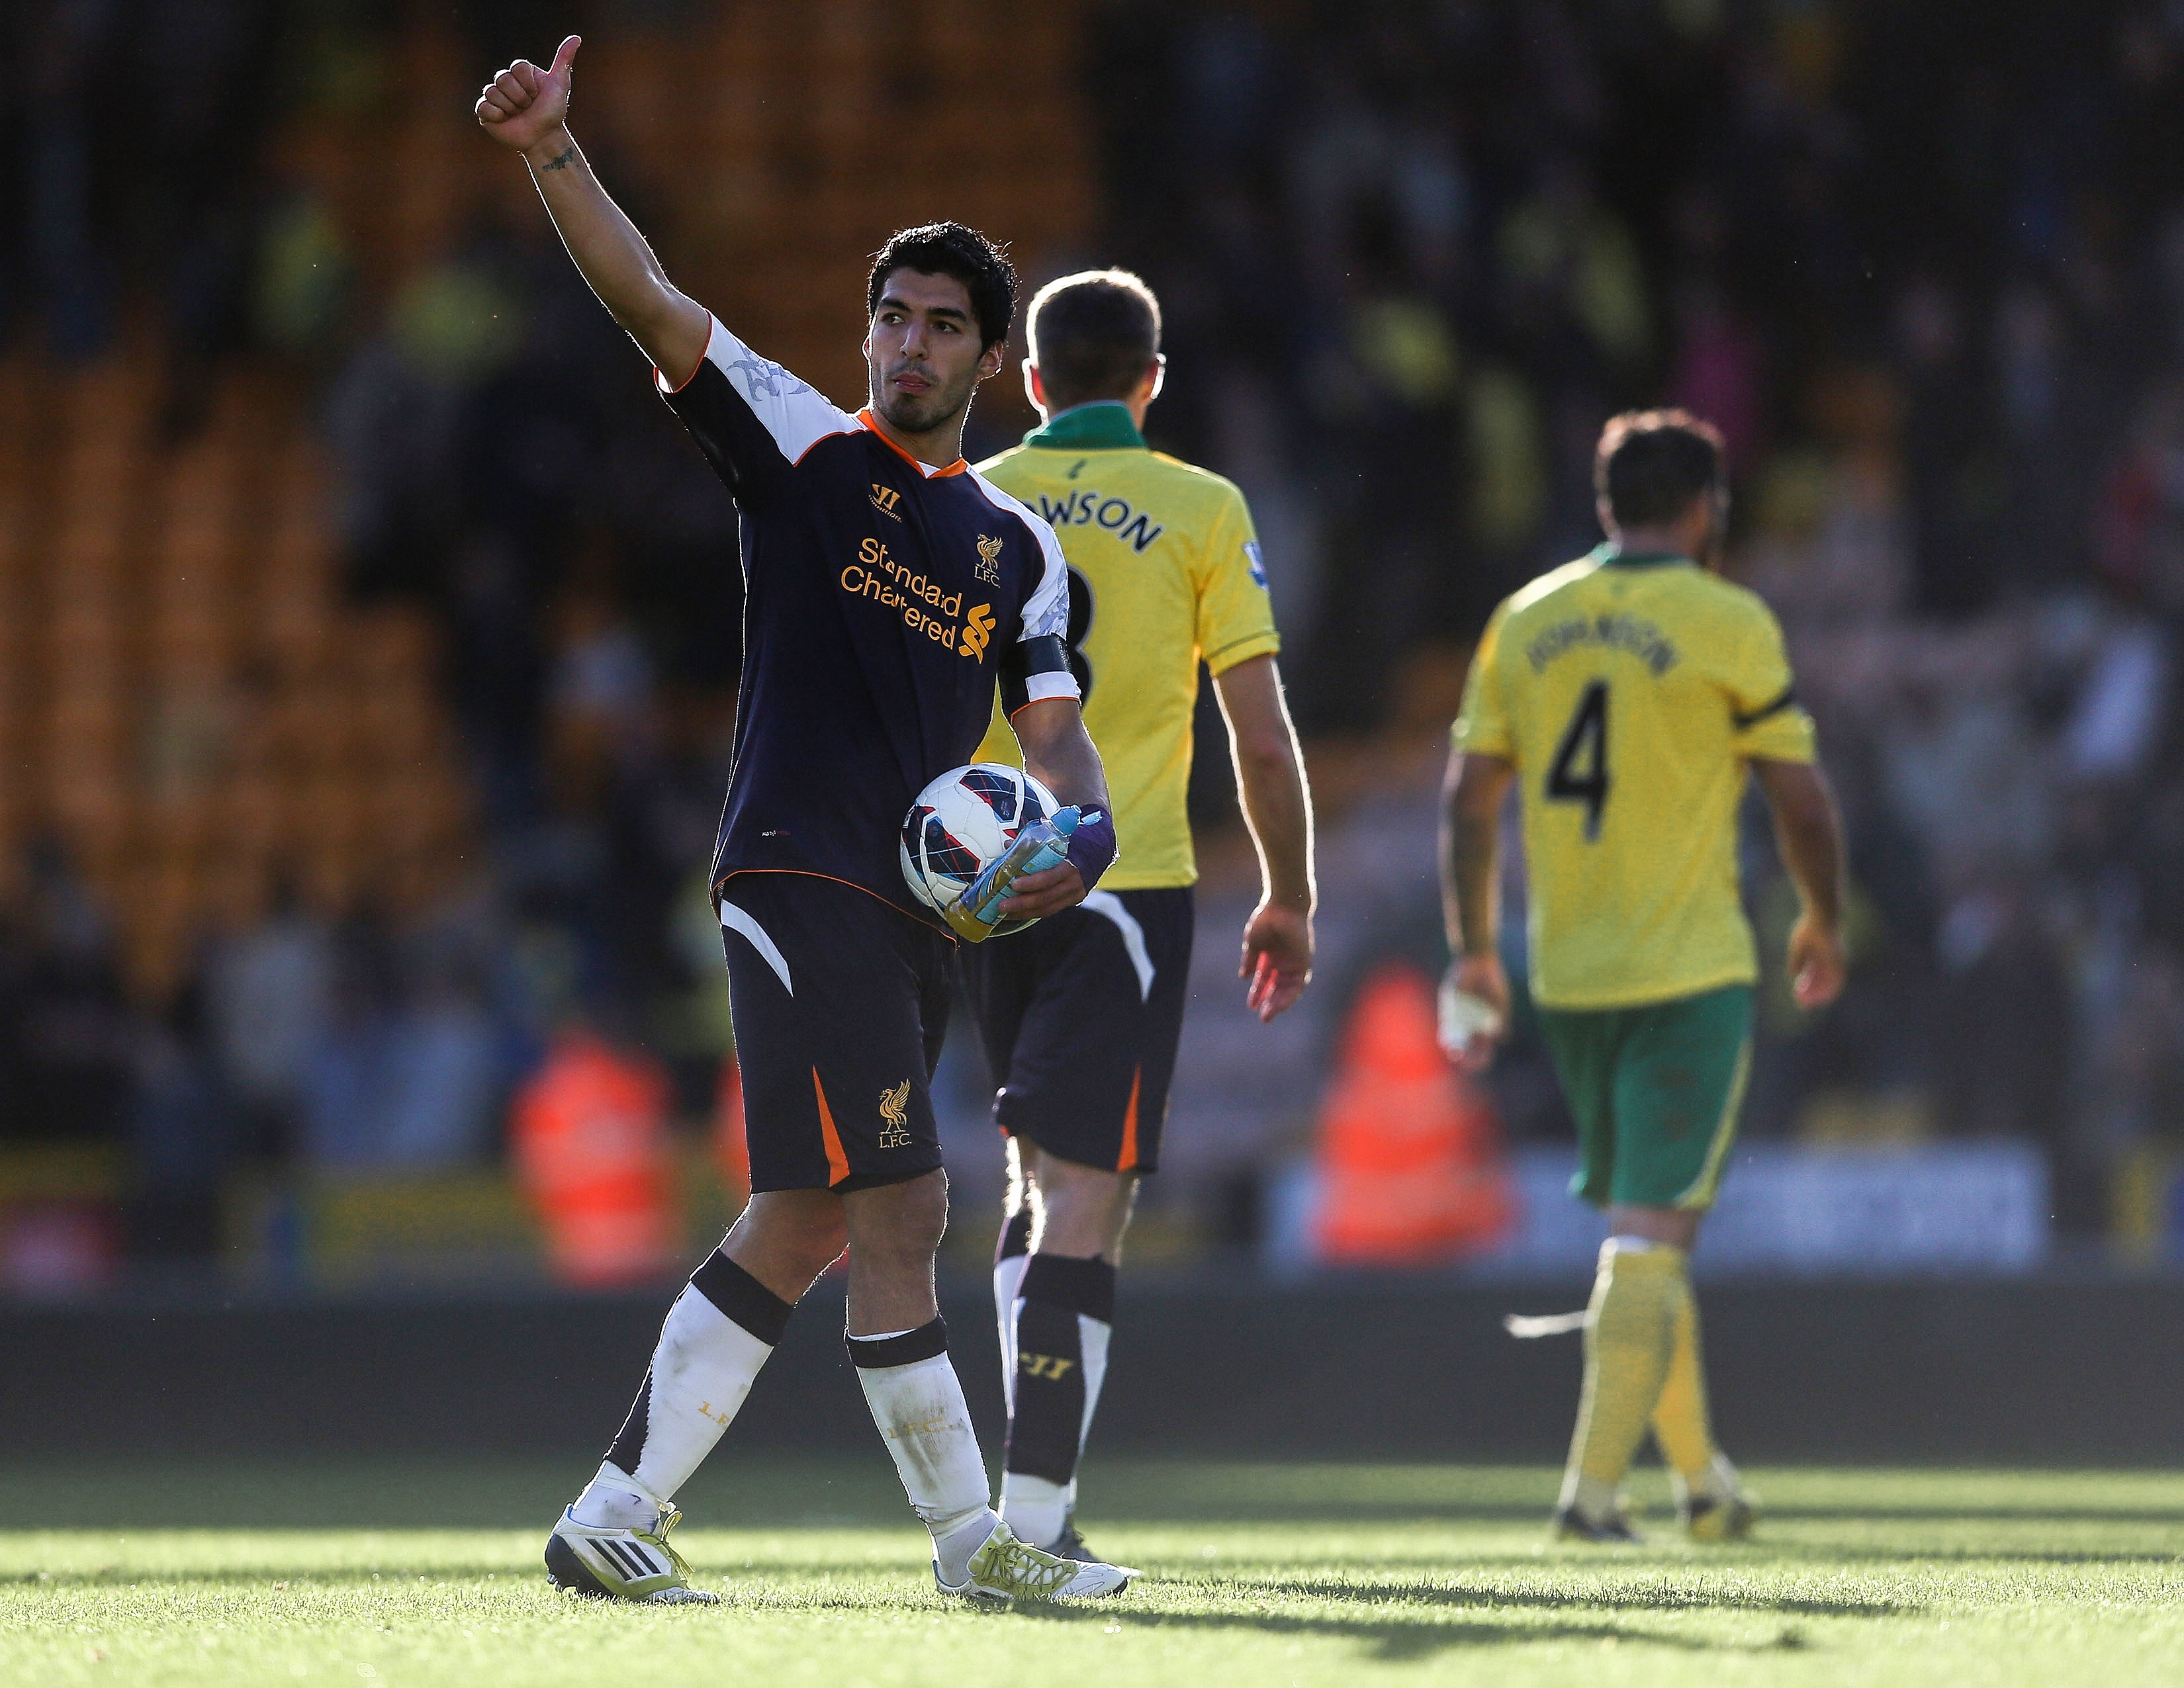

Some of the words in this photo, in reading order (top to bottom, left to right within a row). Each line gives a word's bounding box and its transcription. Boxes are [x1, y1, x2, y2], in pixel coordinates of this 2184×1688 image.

[974, 565, 1001, 588] L.F.C.
[1545, 676, 1611, 842] 4
[879, 1133, 912, 1148] L.F.C.
